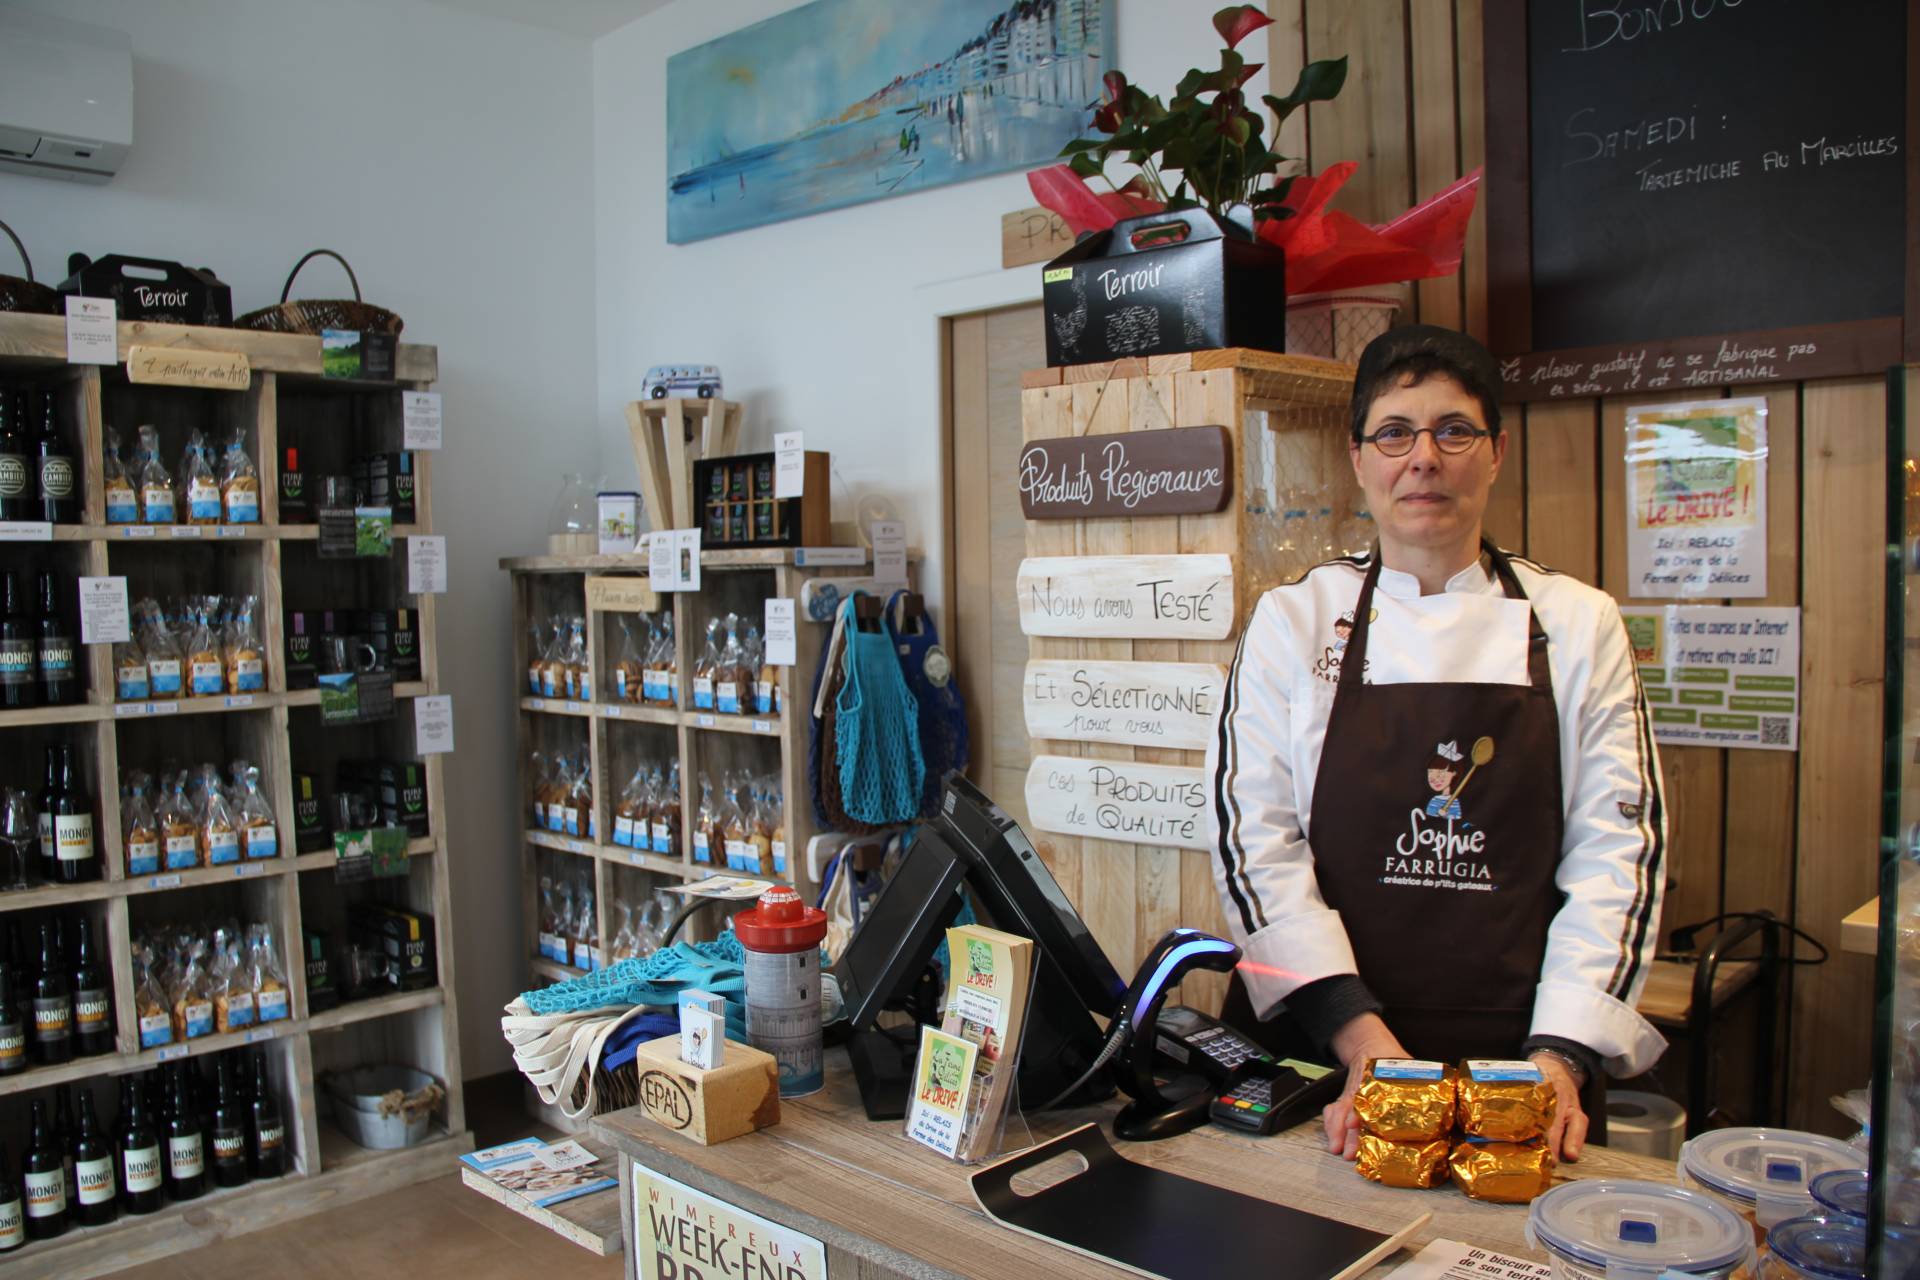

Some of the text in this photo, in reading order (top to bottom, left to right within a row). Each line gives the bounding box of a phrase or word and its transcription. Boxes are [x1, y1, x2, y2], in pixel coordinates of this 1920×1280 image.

[1562, 0, 1743, 52] BONJO
[1562, 104, 1698, 169] SAMEDI
[1763, 151, 1790, 171] AU
[1098, 263, 1164, 301] Terroir
[133, 285, 189, 308] Terroir
[1530, 357, 1583, 384] plaisir
[1686, 353, 1703, 367] se
[1713, 340, 1777, 369] fabrique
[1787, 344, 1817, 362] pas
[1648, 373, 1671, 388] est
[1682, 365, 1780, 387] ARTISANAL
[1019, 441, 1223, 508] Produits Régionaux
[1647, 497, 1668, 525] Le
[1675, 486, 1736, 522] DRIVE
[1688, 536, 1736, 549] RELAIS
[1642, 571, 1679, 585] Ferme
[1708, 570, 1751, 584] Délices
[1032, 577, 1085, 619] Nous
[1094, 596, 1134, 620] avons
[1034, 673, 1057, 700] Et
[1064, 714, 1165, 736] pour vous
[1066, 804, 1087, 826] de
[1396, 807, 1487, 861] Sophie
[1385, 856, 1493, 880] FARRUGIA
[1422, 878, 1434, 887] de
[975, 972, 994, 989] DRIVE
[36, 1008, 70, 1023] MONGY
[644, 1077, 685, 1122] EPAL
[920, 1082, 932, 1101] Le
[932, 1086, 959, 1110] DRIVE
[933, 1114, 953, 1129] RELAIS
[0, 1214, 22, 1228] ONGY
[649, 1186, 803, 1267] WIMEREUX
[1458, 1256, 1475, 1267] de
[1478, 1262, 1502, 1275] son
[1468, 1248, 1486, 1260] Un
[1489, 1254, 1533, 1273] biscuit
